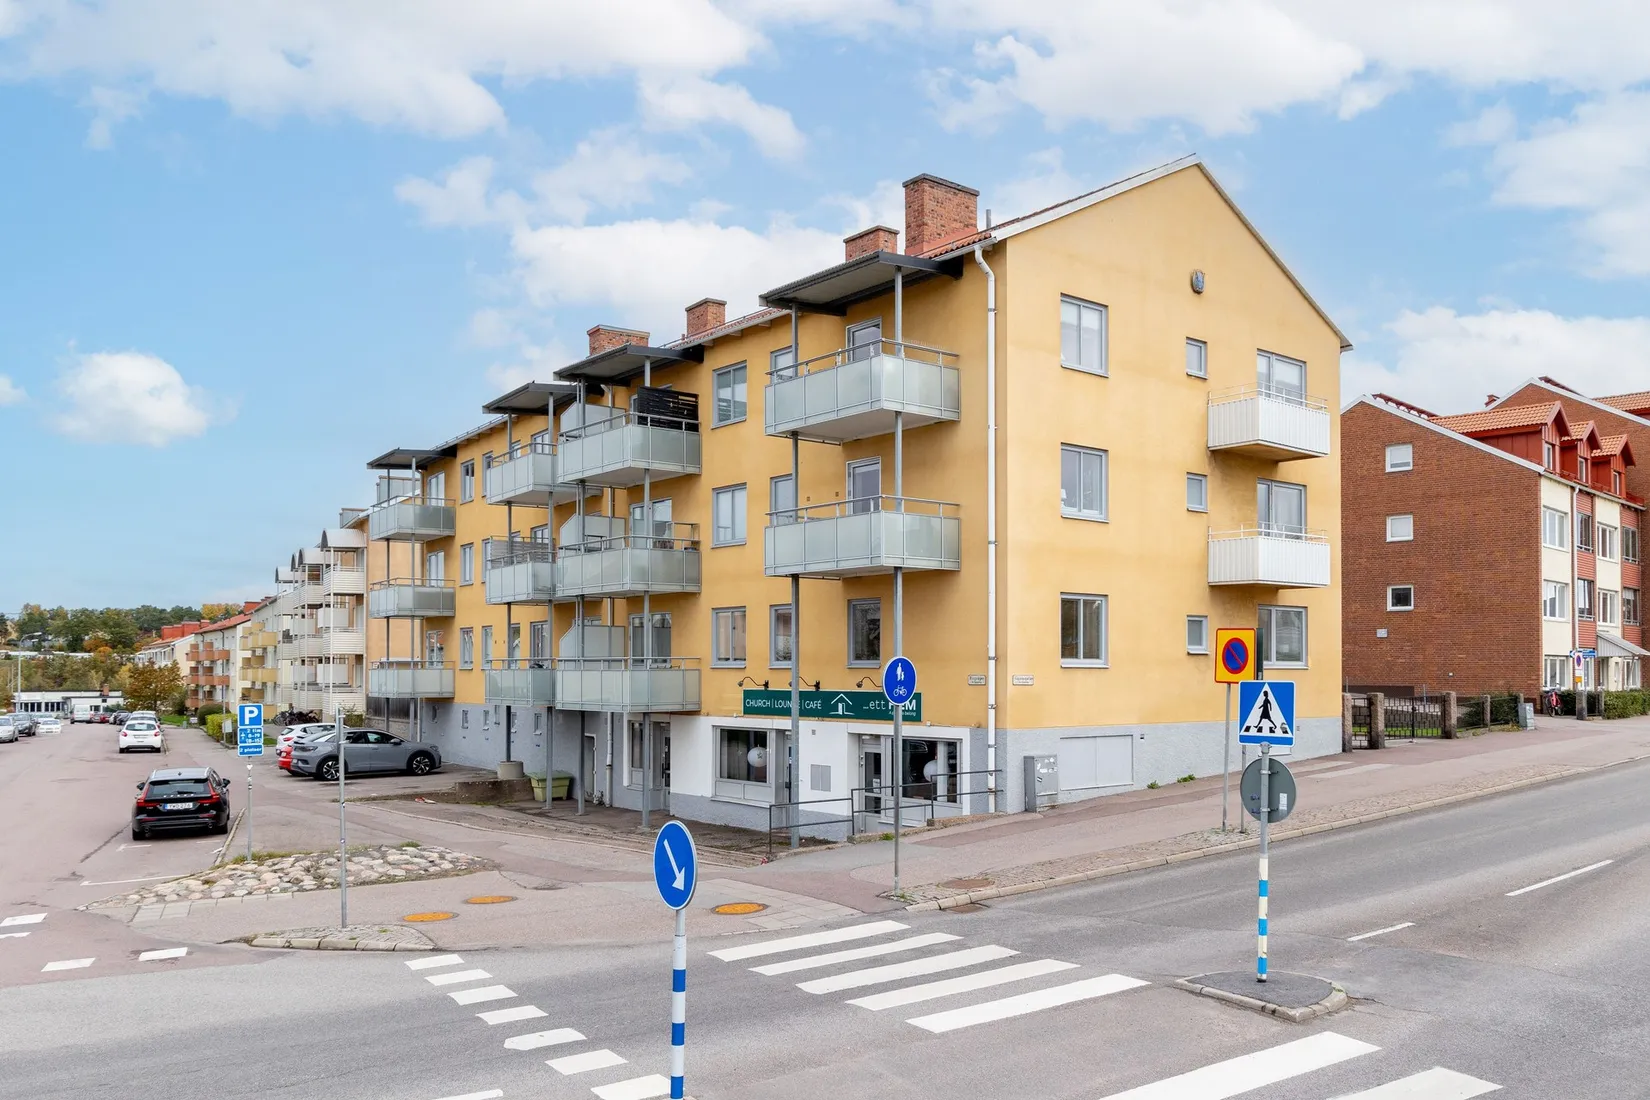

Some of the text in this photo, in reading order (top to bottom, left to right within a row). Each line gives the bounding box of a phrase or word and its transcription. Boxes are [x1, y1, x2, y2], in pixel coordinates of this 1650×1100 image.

[745, 698, 822, 710] CHURCH LOUN CAFÉ
[244, 706, 259, 725] P
